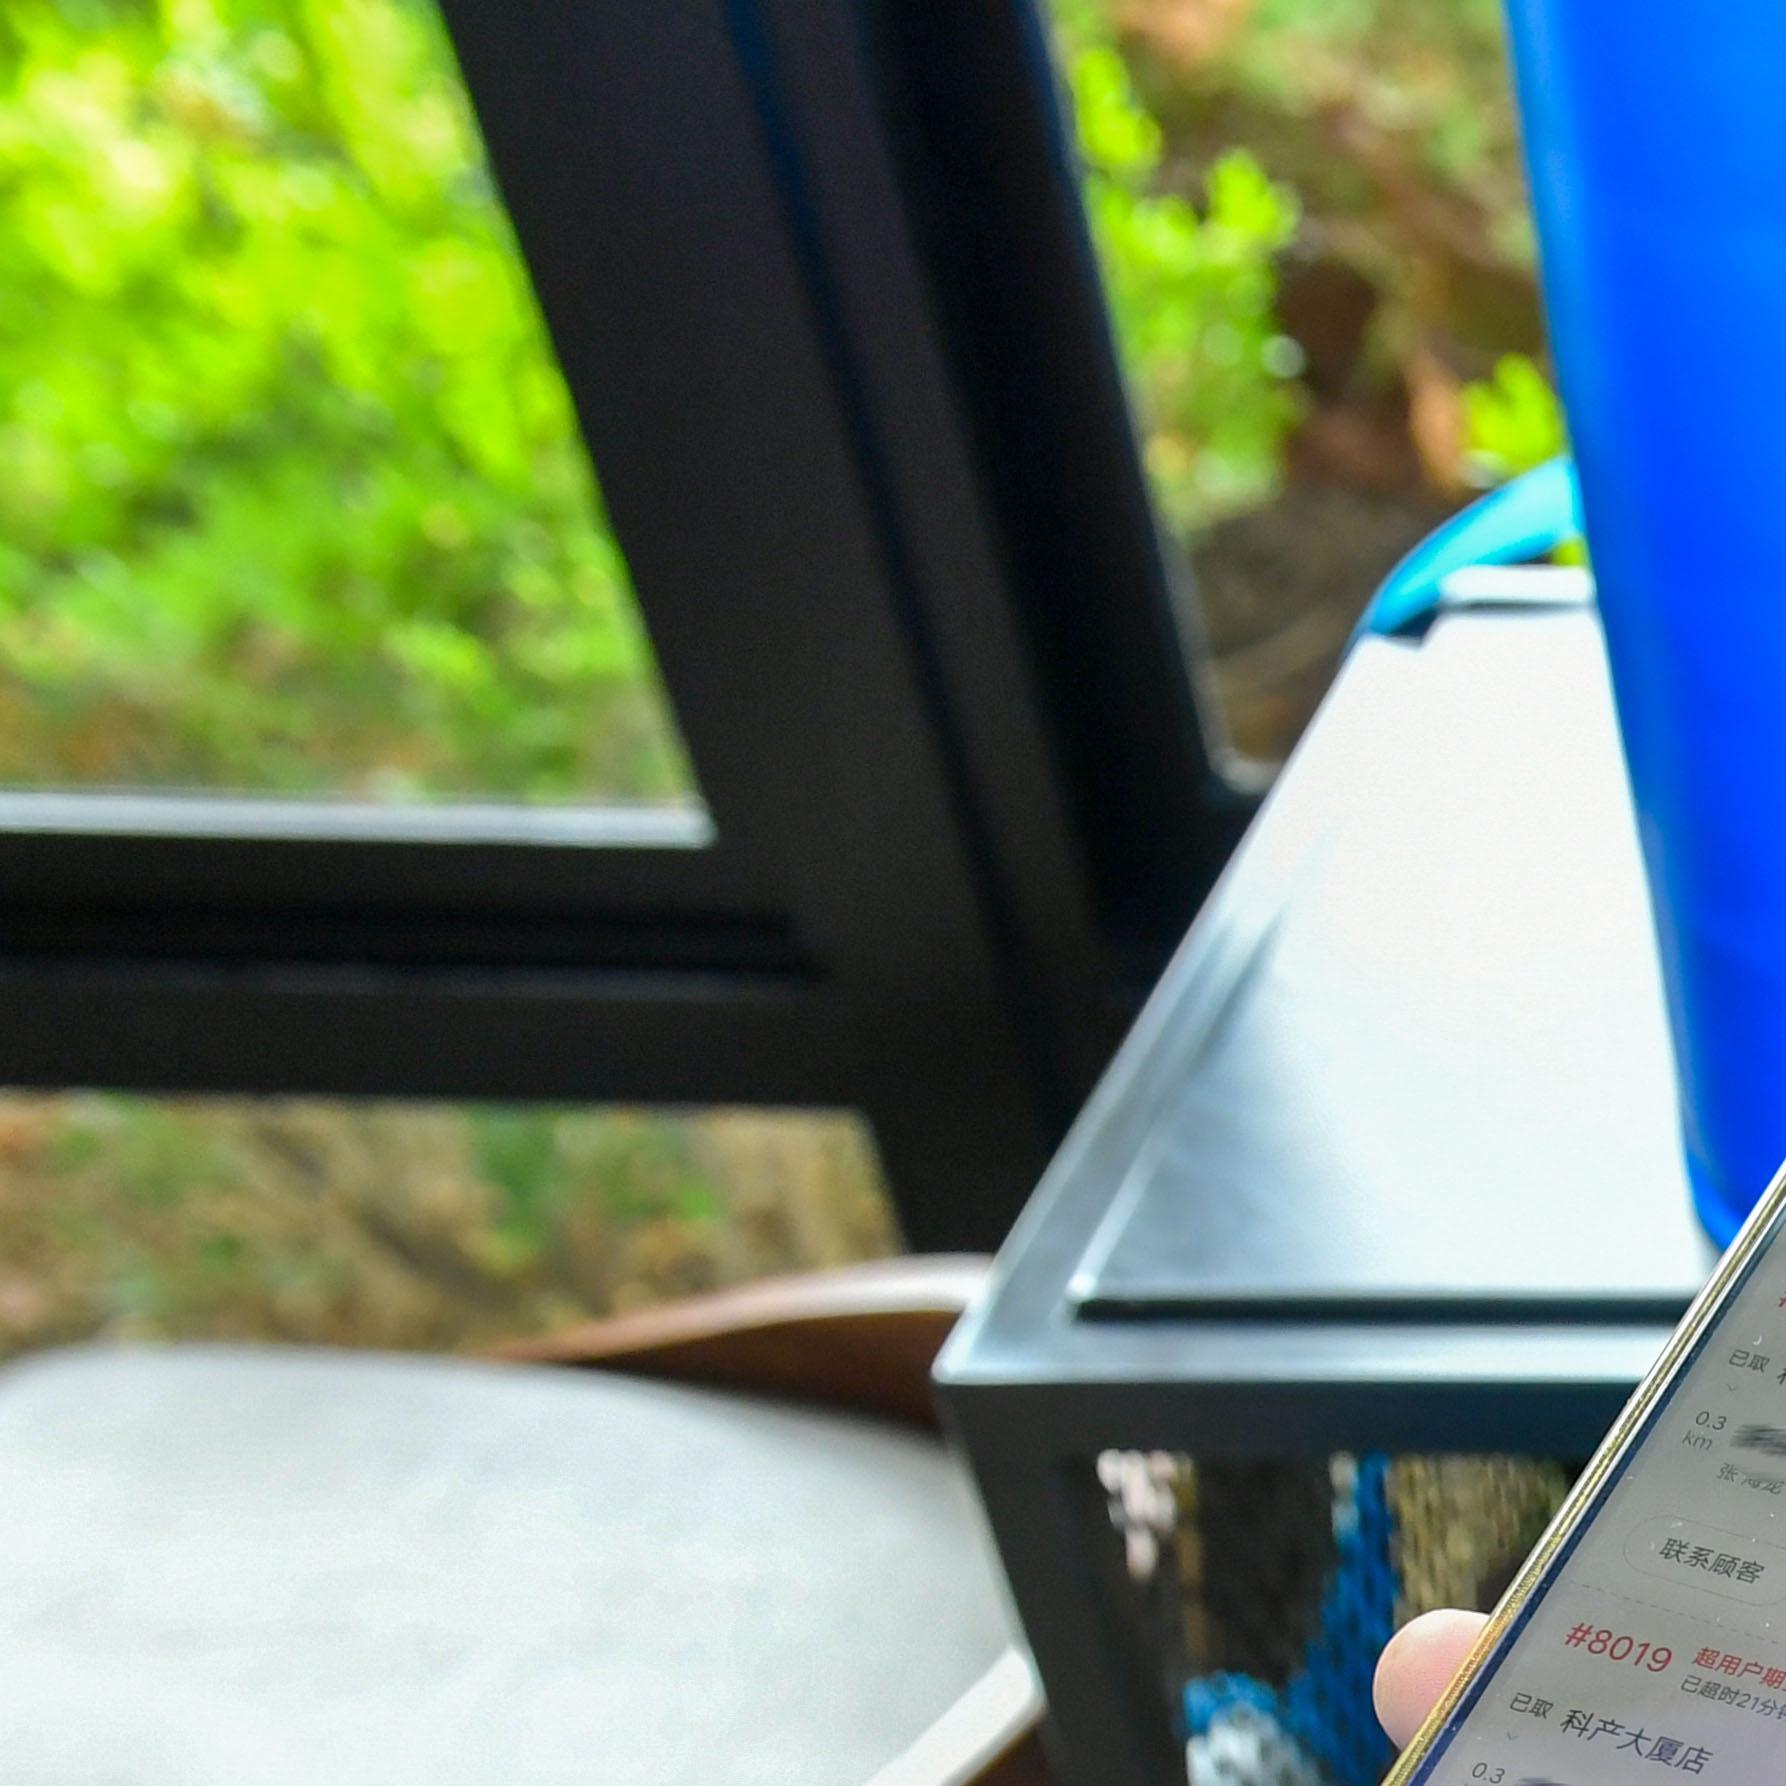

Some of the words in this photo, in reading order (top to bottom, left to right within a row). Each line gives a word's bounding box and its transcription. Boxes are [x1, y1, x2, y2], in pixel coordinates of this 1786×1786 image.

[1727, 1348, 1771, 1374] 已取
[1695, 1410, 1728, 1431] 0.3
[1681, 1431, 1714, 1451] km
[1657, 1537, 1766, 1585] 联系顾客
[1564, 1622, 1673, 1673] #8019
[1508, 1691, 1555, 1720] 已取
[1559, 1708, 1714, 1776] 科产大厦店
[1470, 1760, 1506, 1785] 0.3
